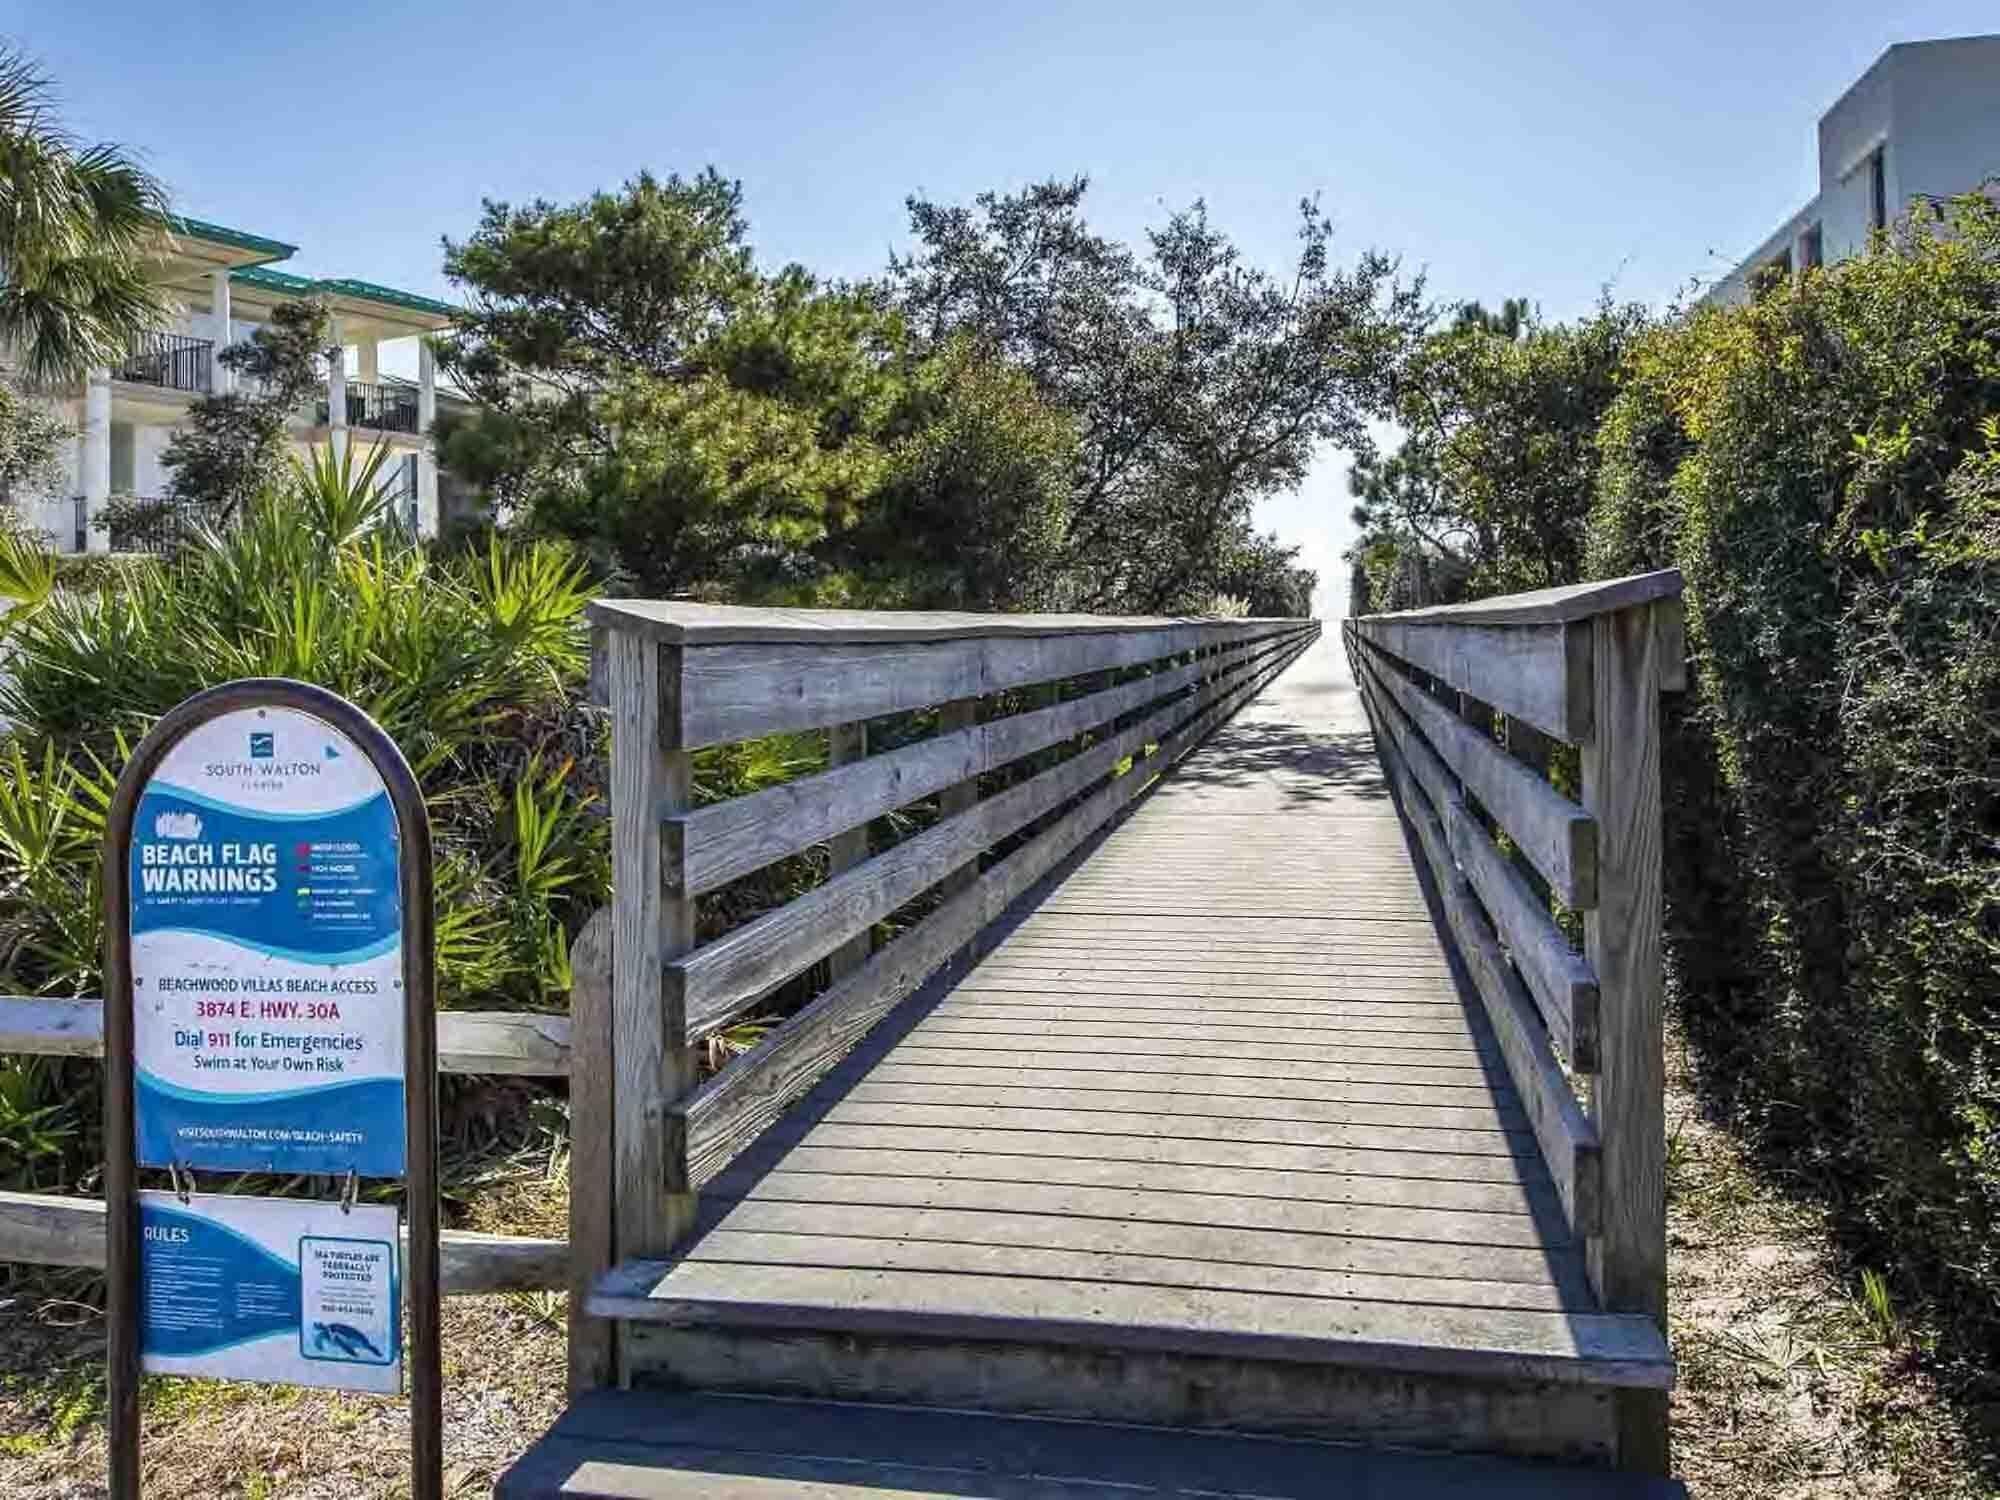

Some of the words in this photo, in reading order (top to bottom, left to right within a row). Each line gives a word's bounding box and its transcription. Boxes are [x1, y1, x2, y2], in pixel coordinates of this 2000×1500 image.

[205, 763, 253, 777] SOUTH
[260, 761, 321, 776] WALTON
[142, 844, 213, 864] BEACH
[222, 844, 277, 864] FLAG
[142, 868, 278, 892] WARNINGS
[158, 976, 238, 993] BEACHWOOD
[240, 977, 283, 993] VILLAS
[286, 979, 328, 993] BEACH
[330, 981, 378, 994] ACCESS
[196, 1001, 235, 1018] 3874
[240, 1002, 256, 1018] E.
[260, 1002, 303, 1019] HWY.
[307, 1003, 341, 1019] 30A
[174, 1030, 204, 1046] Dial
[208, 1033, 231, 1047] 911
[234, 1031, 257, 1047] for
[261, 1033, 363, 1053] Emergencies
[193, 1055, 231, 1069] Swim
[233, 1057, 247, 1069] at
[250, 1056, 280, 1071] Your
[282, 1056, 314, 1071] Own
[316, 1056, 344, 1072] Risk
[144, 1226, 190, 1242] RULES
